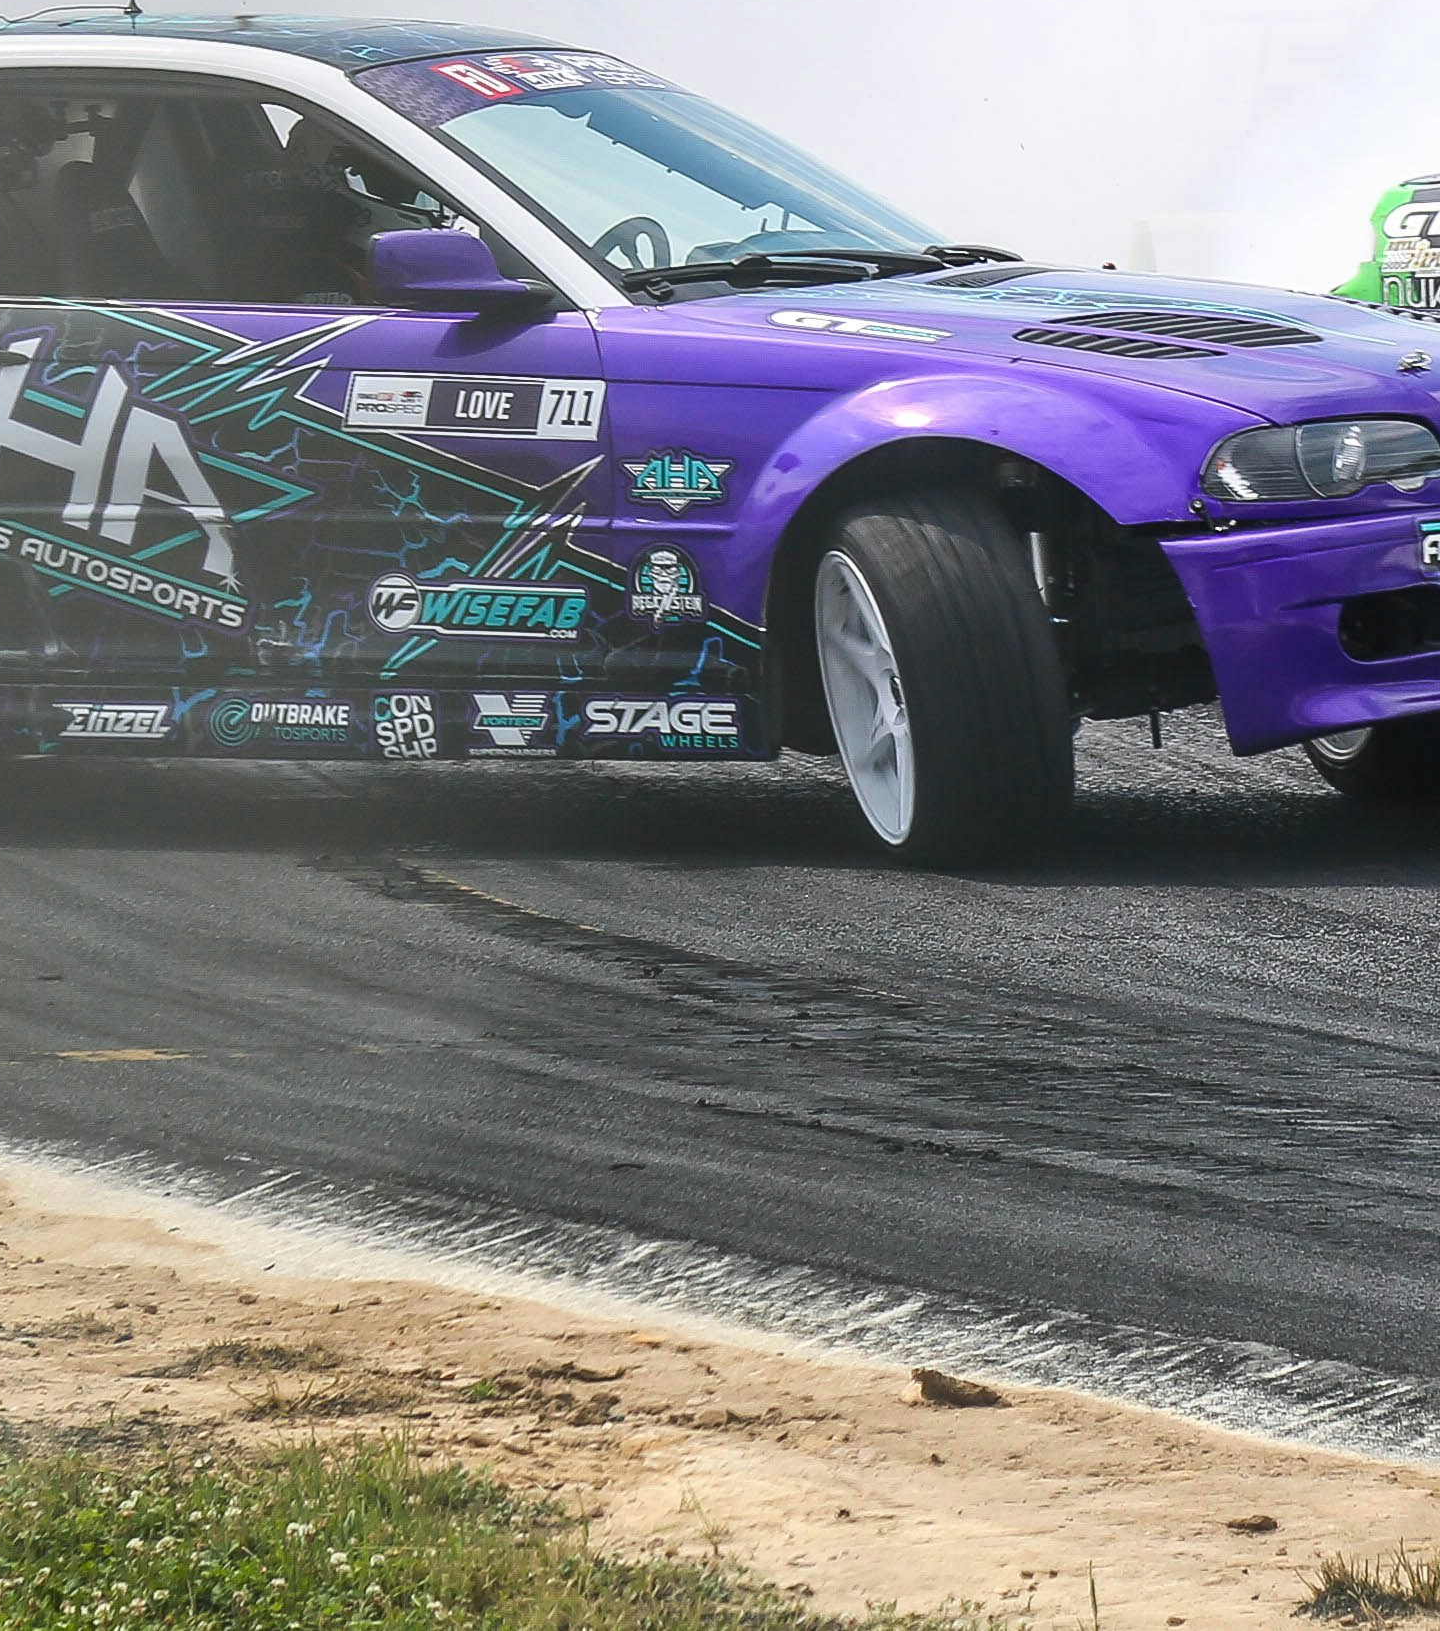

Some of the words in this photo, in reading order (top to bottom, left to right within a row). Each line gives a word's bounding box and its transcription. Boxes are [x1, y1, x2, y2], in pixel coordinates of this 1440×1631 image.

[454, 389, 515, 421] LOVE
[547, 390, 595, 427] 711
[20, 536, 247, 630] AUTOSPORTS
[420, 591, 587, 629] WISEFAB
[373, 694, 433, 722] CON
[481, 716, 541, 727] VORTECH
[584, 700, 739, 736] STAGE
[375, 713, 436, 747] SPD
[661, 733, 739, 749] WHEELS
[468, 748, 557, 757] SUPERCHARGERS
